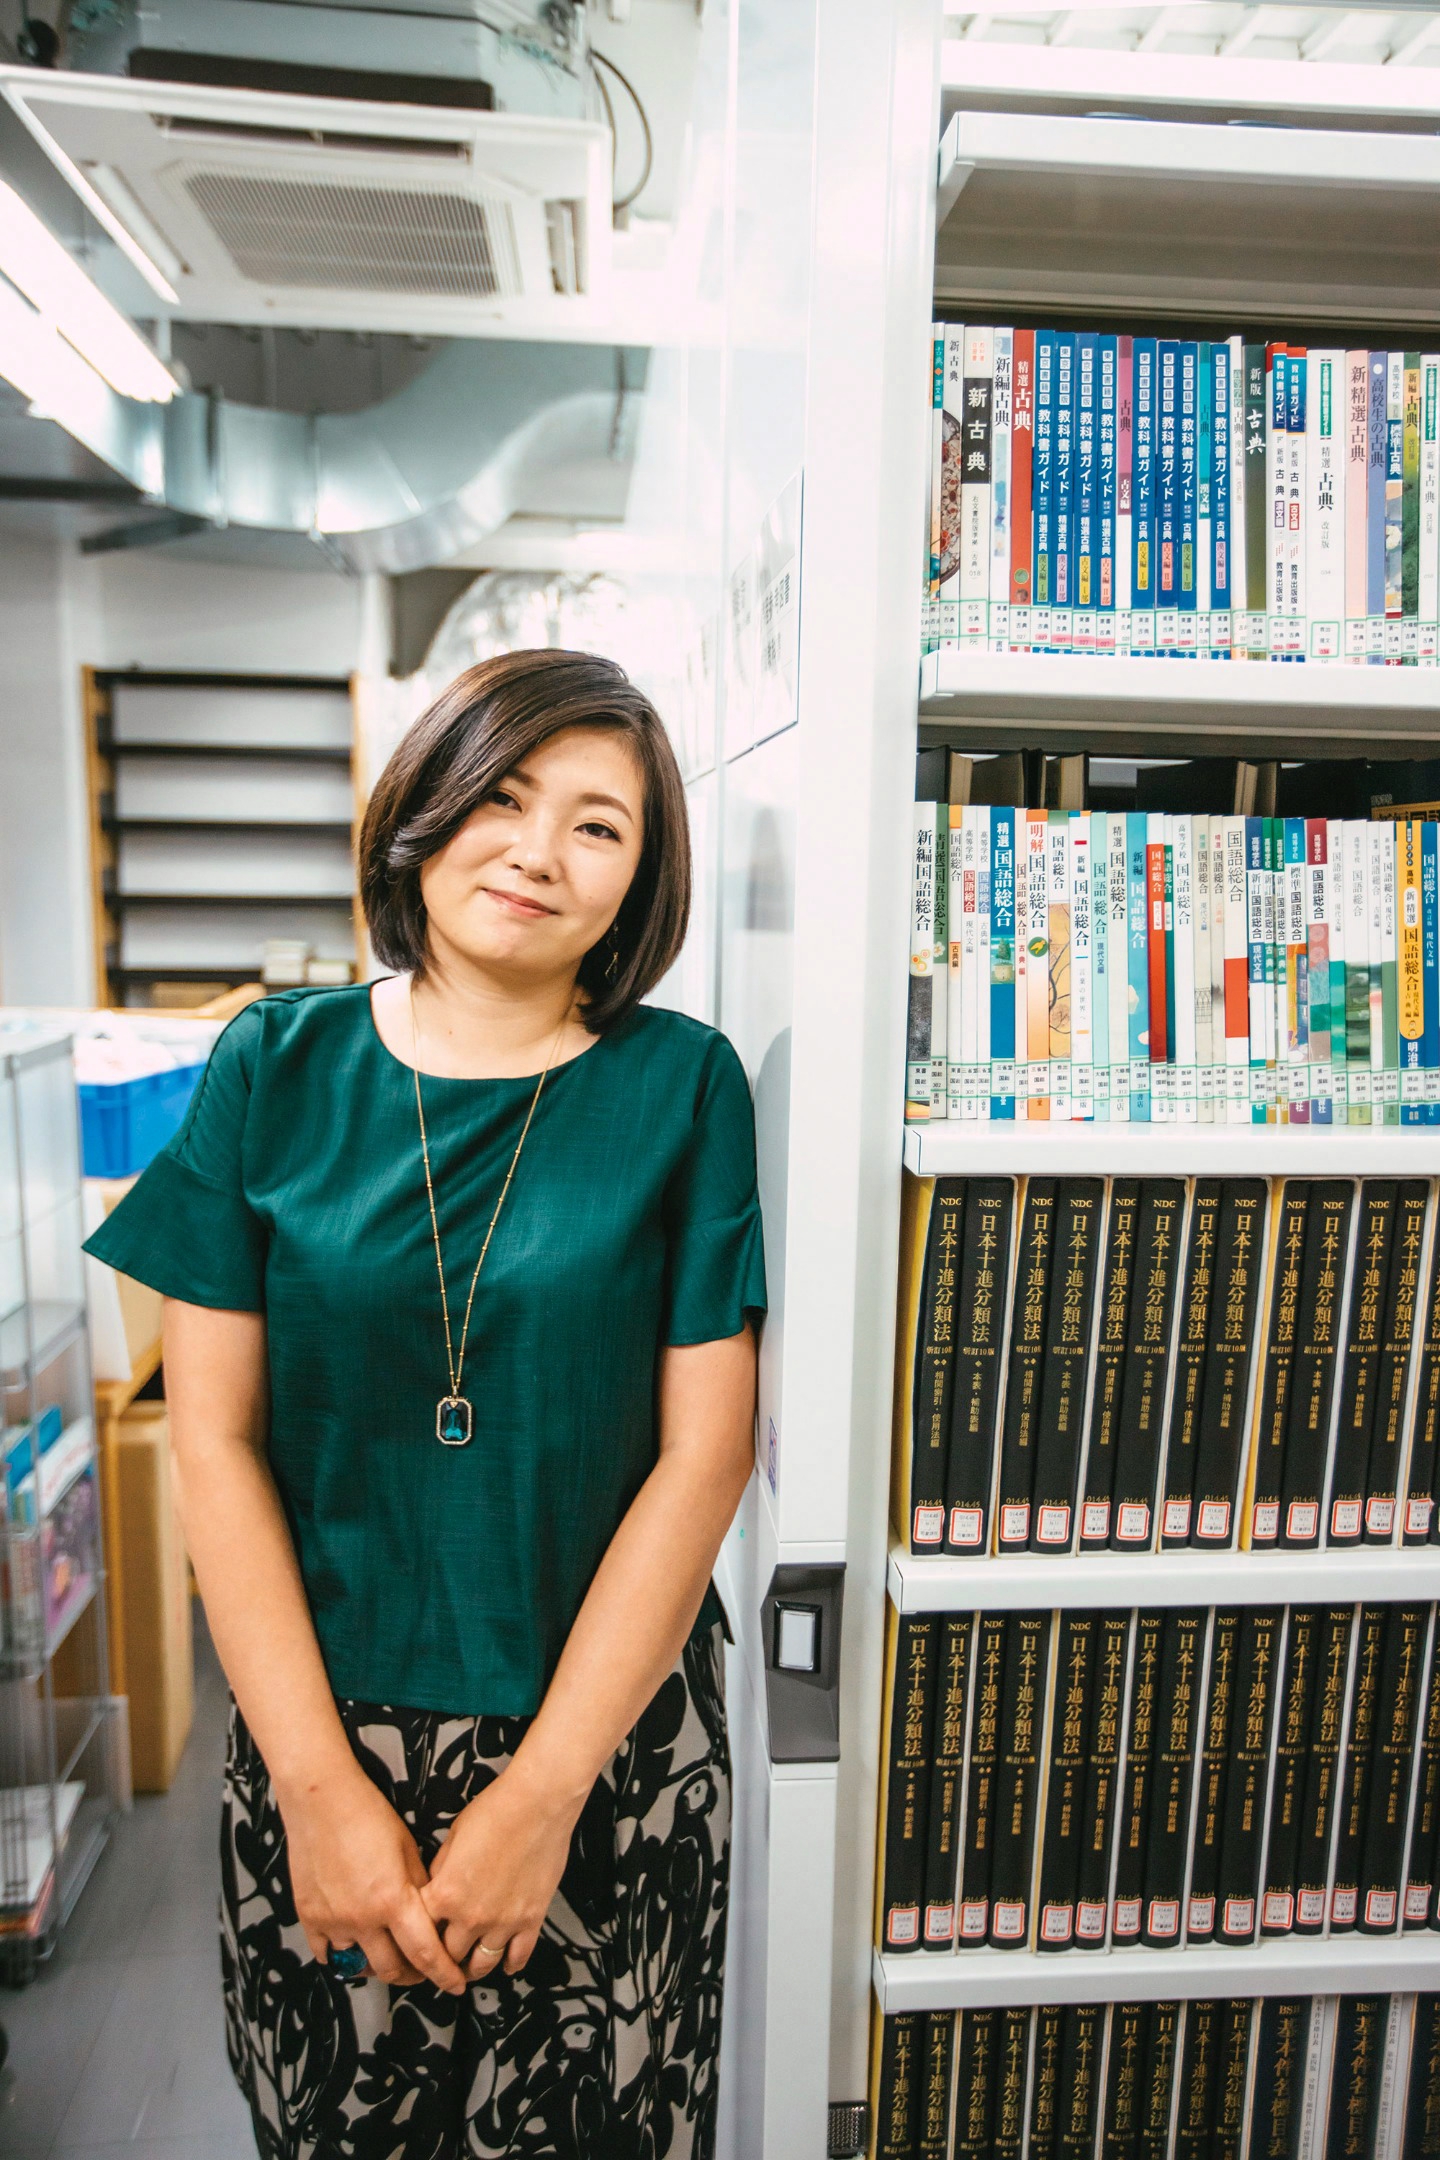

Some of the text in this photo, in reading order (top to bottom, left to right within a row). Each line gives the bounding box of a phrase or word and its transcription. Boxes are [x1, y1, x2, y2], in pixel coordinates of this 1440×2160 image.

[949, 340, 960, 382] 新古典
[995, 357, 1010, 427] 新編古典
[1014, 360, 1031, 433] 精選 古典
[1245, 367, 1266, 455] 新版 古典
[1350, 366, 1367, 463] 新精選古典
[1391, 365, 1400, 400] 高等学校
[1405, 373, 1418, 431] 新編 古典
[967, 388, 987, 472] 新古典
[1038, 345, 1051, 493] 東京書籍版 教科書ガイド
[1058, 345, 1071, 494] 東京書籍版 教科書ガイド
[1079, 348, 1093, 496] 東京書籍版 教科書ガイド
[1100, 350, 1114, 498] 東京書籍版 教科書ガイド
[1119, 400, 1131, 509] 古典 古文編
[1137, 353, 1151, 500] 東京書籍版 教科書ガイド
[1161, 353, 1174, 500] 東京書籍版 教科書ガイド
[1181, 355, 1195, 501] 東京書籍版 教科書ガイド
[1199, 404, 1210, 513] 古典 漢文編
[1214, 354, 1227, 500] 東京書籍版 教科書ガイド
[1321, 446, 1331, 469] 精選
[1370, 379, 1385, 468] 高校生の古典
[1275, 469, 1284, 496] 古典
[1290, 472, 1299, 499] 古典
[1318, 473, 1334, 512] 古典
[1425, 474, 1436, 504] 古典
[915, 829, 933, 932] 新編国語総合
[950, 833, 962, 883] 国語総合
[964, 871, 975, 954] 国語総合 現代文編
[978, 872, 990, 947] 国語総合 古典編
[994, 822, 1013, 929] 精選 国語総合
[1029, 824, 1046, 930] 明解 国語総合
[1052, 835, 1065, 891] 国語総合
[1074, 879, 1090, 947] 国語総合
[1077, 856, 1085, 874] 新編
[1110, 825, 1126, 921] 精選 国語総合
[1130, 852, 1146, 950] 新編 国語総合
[1151, 850, 1162, 893] 国語総合
[1176, 824, 1191, 926] 高等学校 国語総合
[1197, 850, 1209, 894] 国語総合
[1213, 850, 1223, 894] 国語総合
[1228, 830, 1243, 903] 国語総合
[1312, 869, 1324, 919] 国語総合
[1332, 852, 1342, 894] 国語総合
[1352, 869, 1363, 918] 国語総合
[1371, 854, 1380, 896] 国語総合
[1383, 862, 1393, 909] 国語総合
[1423, 854, 1435, 968] 国語総合 現代文編
[1016, 863, 1027, 976] 国語総合 古典編
[1093, 862, 1106, 975] 国語総合 現代文編
[1251, 895, 1262, 981] 国語総合 現代文編
[1290, 891, 1302, 941] 国語総合
[1404, 891, 1420, 992] 新精選 国語総合
[940, 1197, 962, 1207] NDC
[978, 1199, 1001, 1209] NDC
[1031, 1197, 1053, 1207] NDC
[1069, 1199, 1092, 1209] NDC
[933, 1213, 958, 1342] 日本十進分類法
[971, 1214, 997, 1343] 日本十進分類法
[1023, 1213, 1049, 1342] 日本十進分類法
[1061, 1214, 1088, 1343] 日本十進分類法
[1106, 1197, 1136, 1341] NDC 日本十進分類法
[1143, 1199, 1176, 1342] NDC 日本十進分類法
[1187, 1198, 1218, 1341] NDC 日本十進分類法
[1224, 1198, 1257, 1341] NDC 日本十進分類法
[1277, 1200, 1307, 1342] NDC 日本十進分類法
[1312, 1201, 1344, 1342] NDC 日本十進分類法
[1358, 1200, 1390, 1341] NDC 日本十進分類法
[1393, 1199, 1425, 1340] NDC 日本十進分類法
[904, 1638, 926, 1757] 日本十進分類法
[942, 1623, 969, 1755] NDC 日本十進分類法
[978, 1634, 1001, 1753] 日本十進分類法
[1013, 1621, 1041, 1753] NDC 日本十進分類法
[1063, 1637, 1087, 1755] 日本十進分類法
[1098, 1621, 1126, 1753] NDC 日本十進分類法
[1133, 1633, 1157, 1751] 日本十進分類法
[1170, 1619, 1198, 1751] NDC 日本十進分類法
[1209, 1632, 1234, 1749] 日本十進分類法
[1245, 1617, 1275, 1750] NDC 日本十進分類法
[1286, 1628, 1311, 1744] 日本十進分類法
[1321, 1611, 1350, 1742] NDC 日本十進分類法
[1355, 1626, 1381, 1741] 日本十進分類法
[1391, 1628, 1417, 1743] 日本十進分類法
[891, 2030, 911, 2144] 日本十進分類法
[926, 2026, 947, 2139] 日本十進分類法
[968, 2026, 989, 2140] 日本十進分類法
[1002, 2024, 1023, 2138] 日本十進分類法
[1037, 2020, 1058, 2133] 日本十進分類法
[1071, 2021, 1093, 2133] 日本十進分類法
[1115, 2019, 1138, 2129] 日本十進分類法
[1149, 2016, 1173, 2127] 日本十進分類法
[1189, 2016, 1211, 2127] 日本十進分類法
[1223, 2013, 1247, 2125] 日本十進分類法
